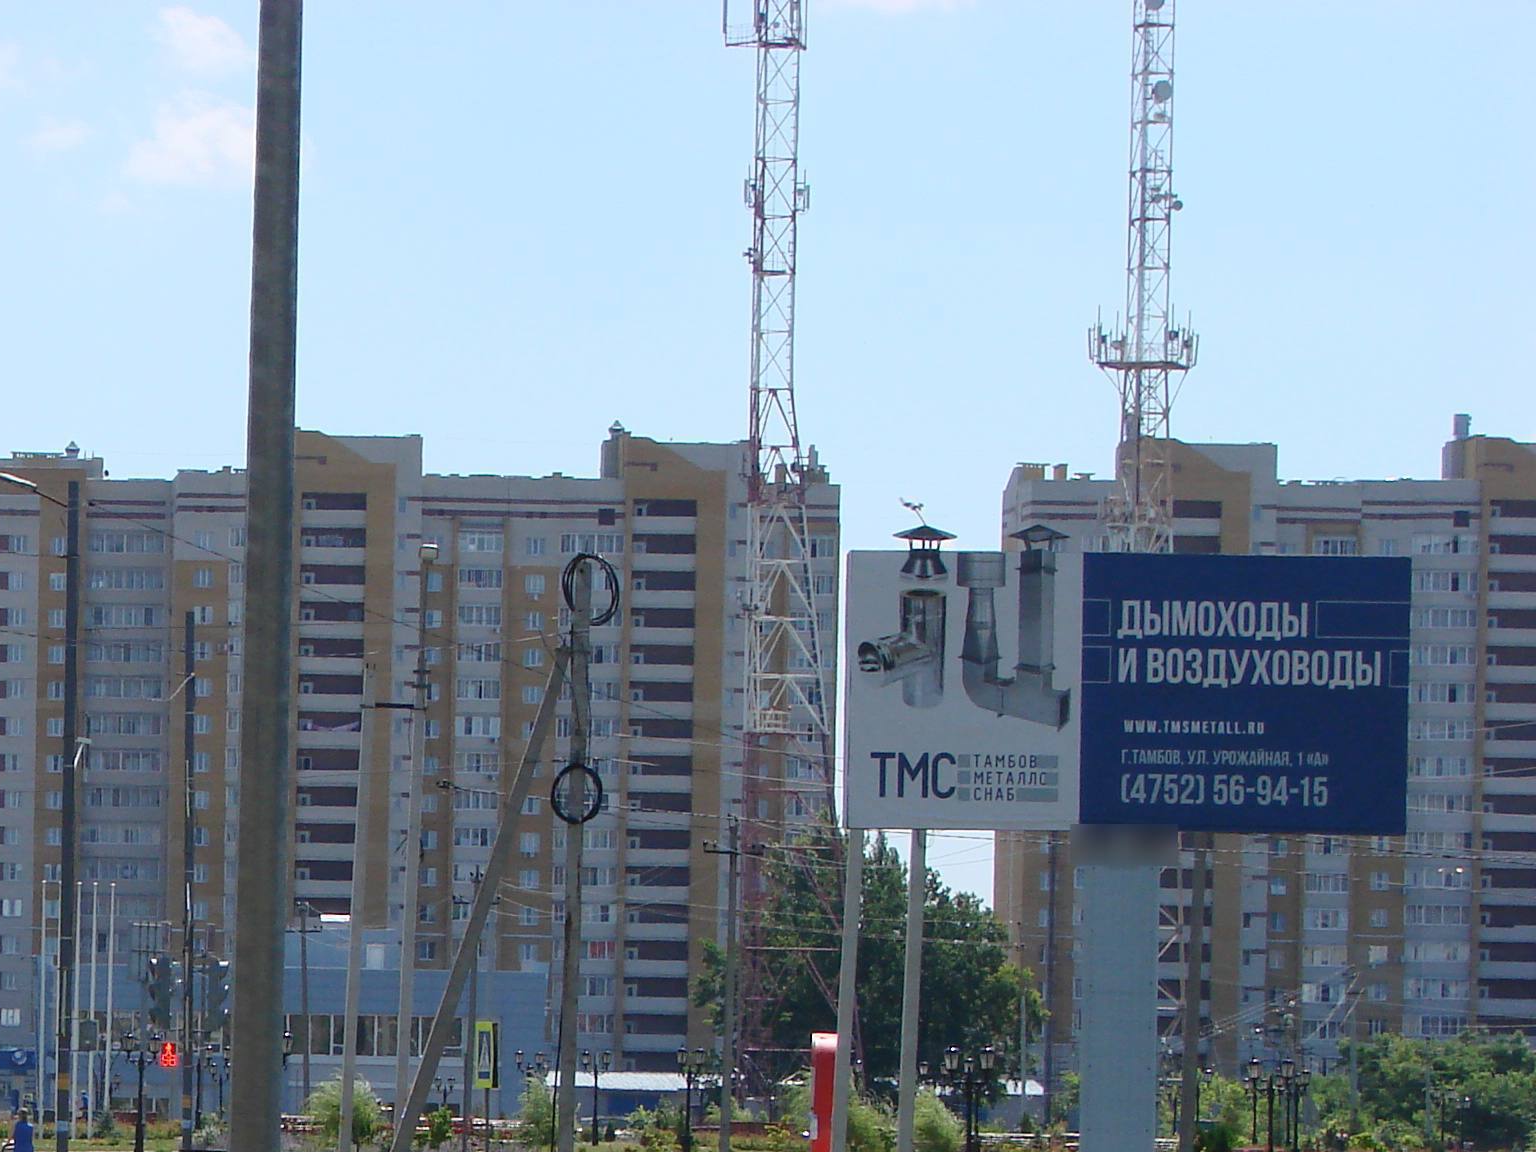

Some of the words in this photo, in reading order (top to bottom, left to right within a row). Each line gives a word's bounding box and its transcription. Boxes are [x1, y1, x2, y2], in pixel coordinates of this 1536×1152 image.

[1117, 599, 1308, 641] ДЫМОХОДЫ
[1118, 648, 1137, 683] И
[1146, 648, 1382, 690] ВОЗДУХОВОДЫ
[1123, 719, 1265, 735] WWW.TMSMETALL.RU
[973, 754, 1038, 769] ТАМБОВ
[870, 752, 957, 799] ТМС
[973, 771, 1047, 786] МЕТАЛЛС
[973, 787, 1015, 801] СНАБ
[1120, 773, 1205, 804] (4752)
[1213, 774, 1329, 807] 56-94-15
